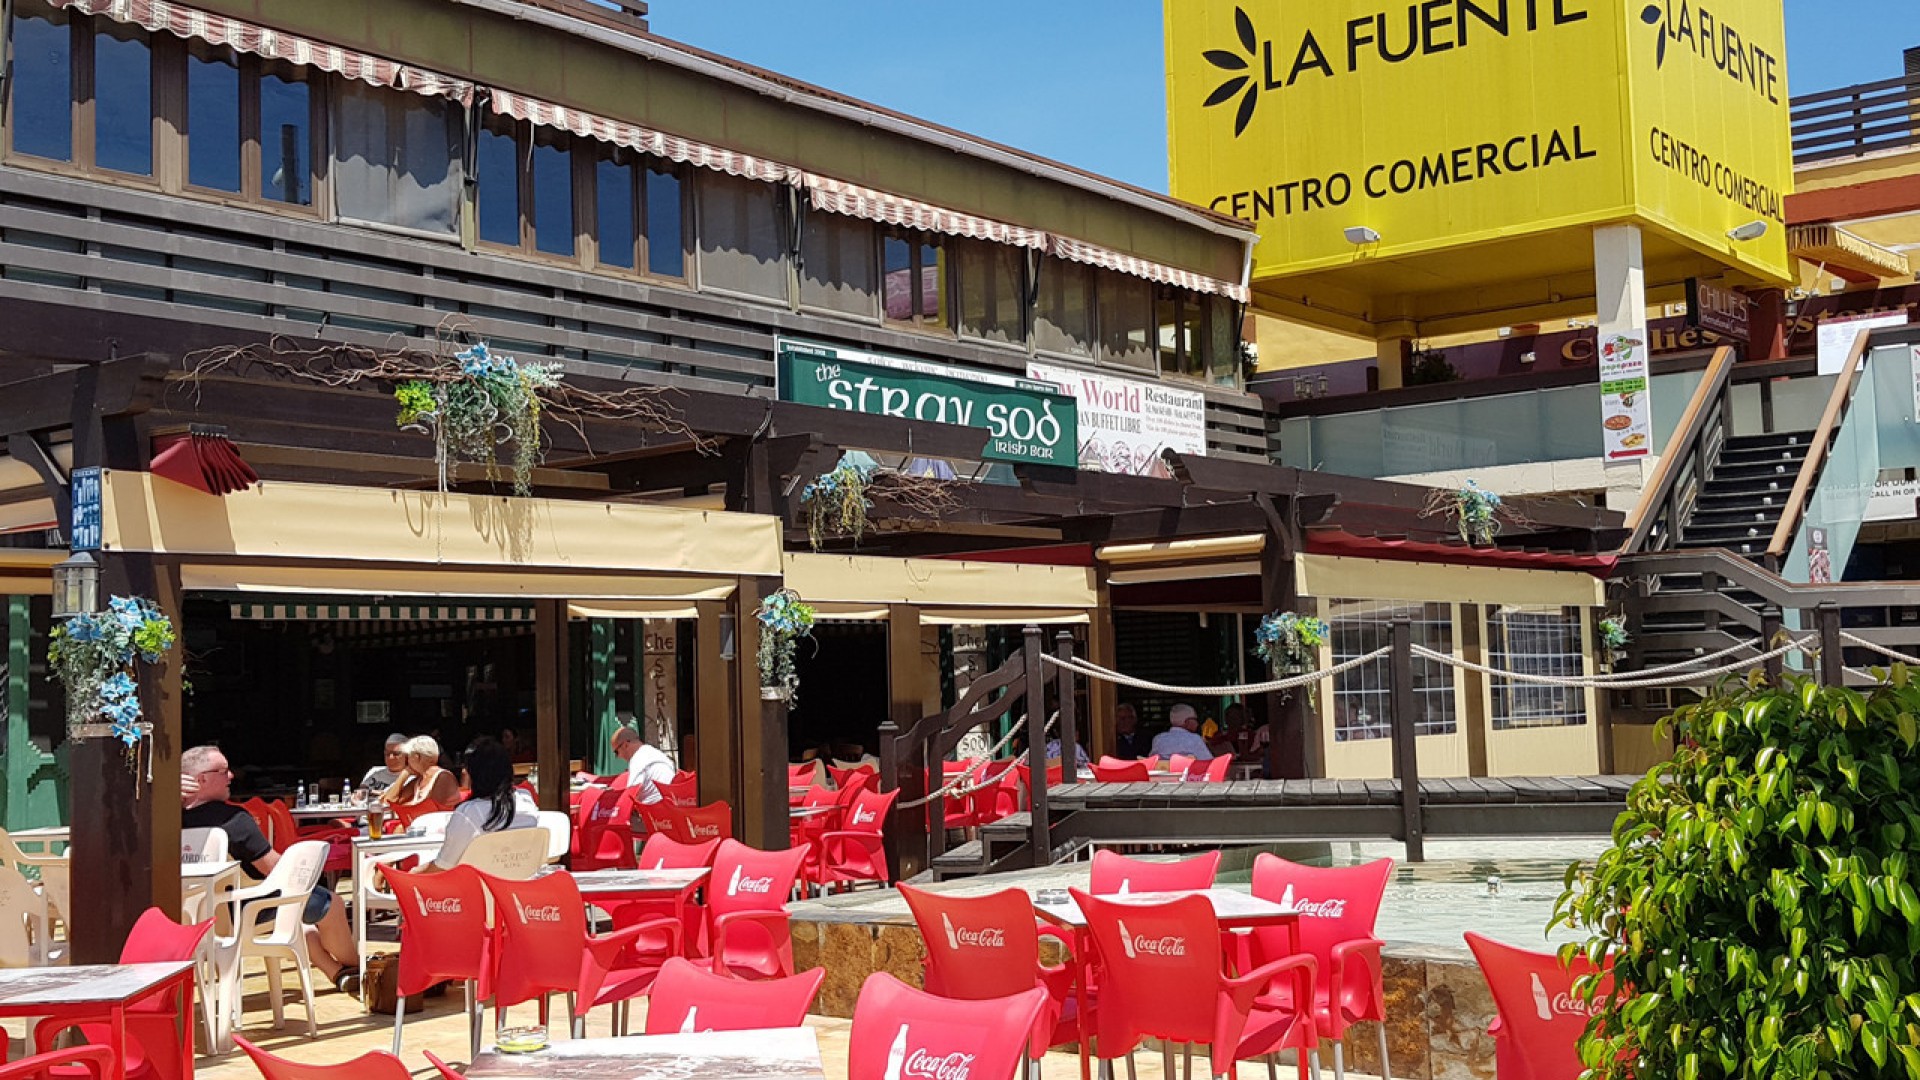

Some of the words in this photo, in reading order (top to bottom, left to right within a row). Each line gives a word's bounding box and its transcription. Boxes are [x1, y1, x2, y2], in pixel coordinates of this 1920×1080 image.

[1263, 29, 1334, 90] LA
[1667, 0, 1697, 53] LA
[1699, 7, 1778, 105] FUENTE
[1364, 125, 1597, 199] COMERCIAL
[1650, 127, 1710, 187] CENTRO
[1714, 162, 1784, 224] COMERCIAL
[815, 363, 840, 381] the
[1082, 378, 1141, 413] World
[1145, 386, 1203, 410] Restaurant
[957, 927, 1006, 947] Coca-Cola
[1134, 935, 1186, 956] Coca-Cola
